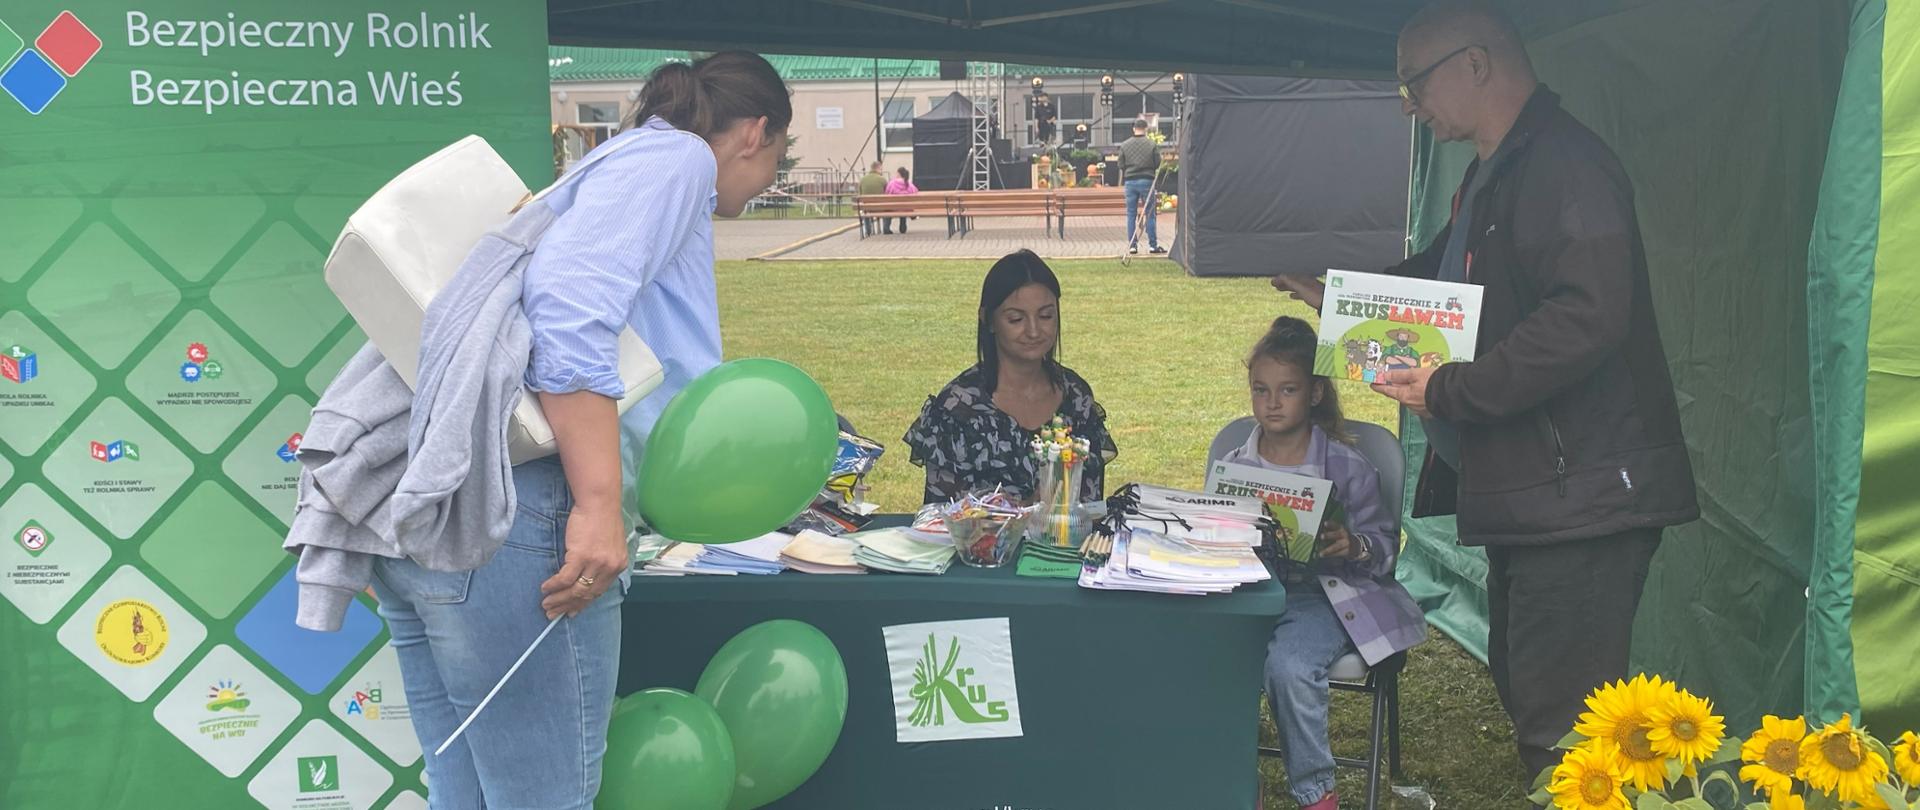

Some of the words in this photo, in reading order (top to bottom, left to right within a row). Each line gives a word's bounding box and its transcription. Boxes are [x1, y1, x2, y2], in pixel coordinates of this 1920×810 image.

[126, 11, 354, 57] Bezpieczny
[367, 11, 492, 48] Rolnik
[130, 69, 358, 114] Bezpieczna
[367, 71, 463, 106] Wieś
[1336, 299, 1466, 331] KRUSŁAWEM
[1371, 293, 1432, 309] BEZPIECZNIE
[1434, 301, 1441, 309] Z
